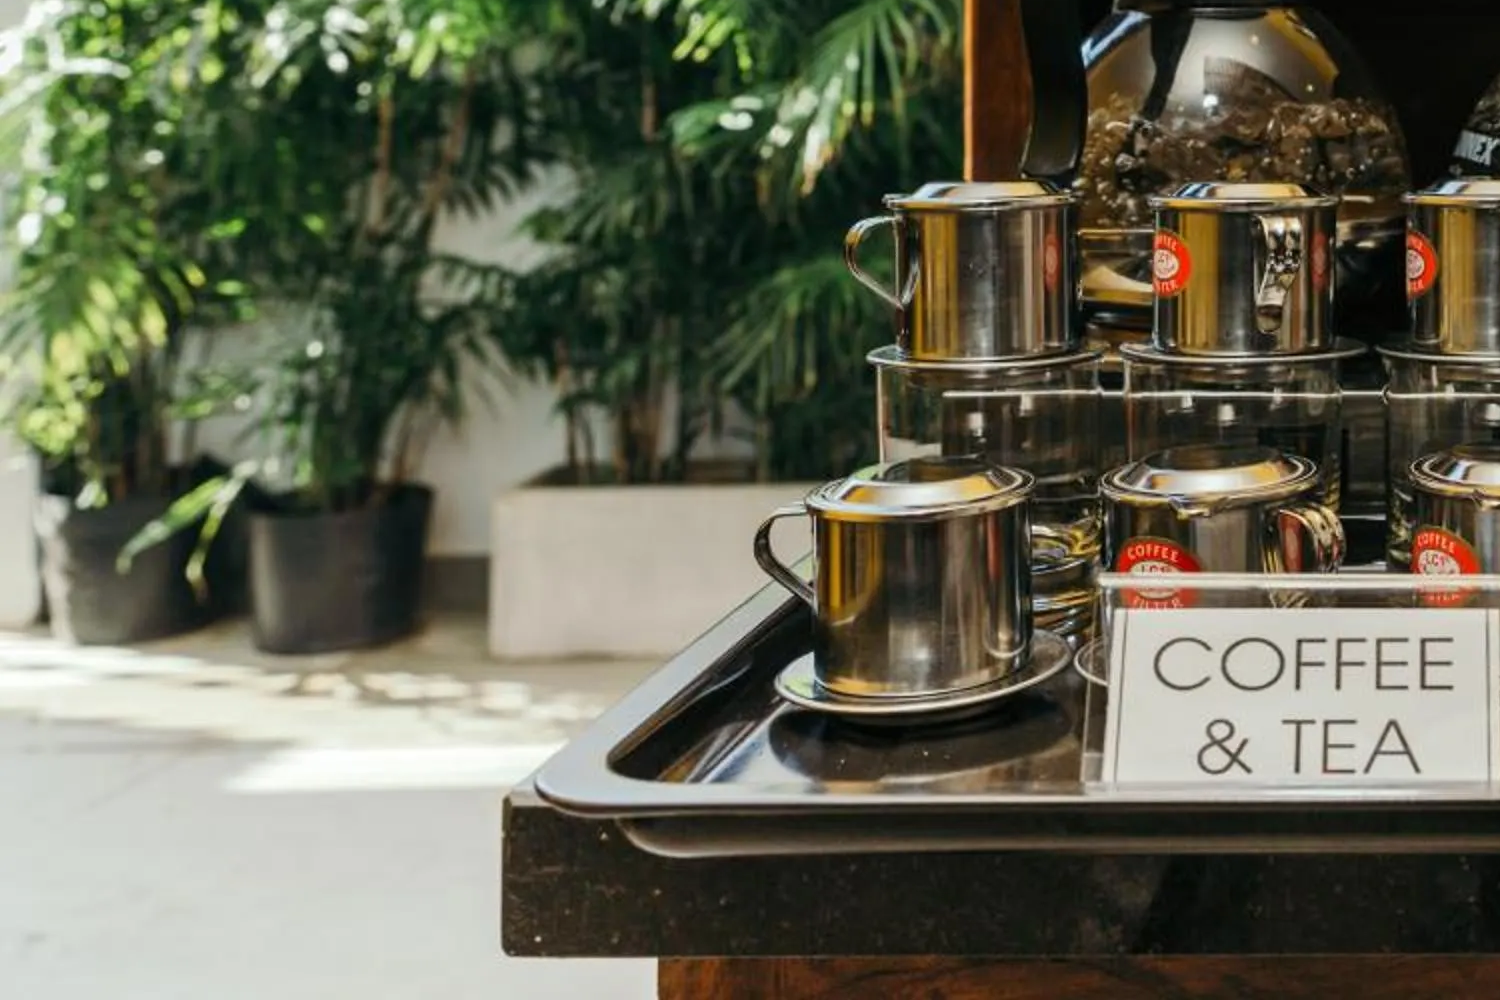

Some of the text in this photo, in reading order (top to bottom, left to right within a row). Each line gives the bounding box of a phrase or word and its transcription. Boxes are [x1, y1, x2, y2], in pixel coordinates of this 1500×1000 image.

[1127, 543, 1180, 563] COFFEE
[1152, 636, 1455, 692] COFFEE
[1196, 717, 1423, 776] & TEA
